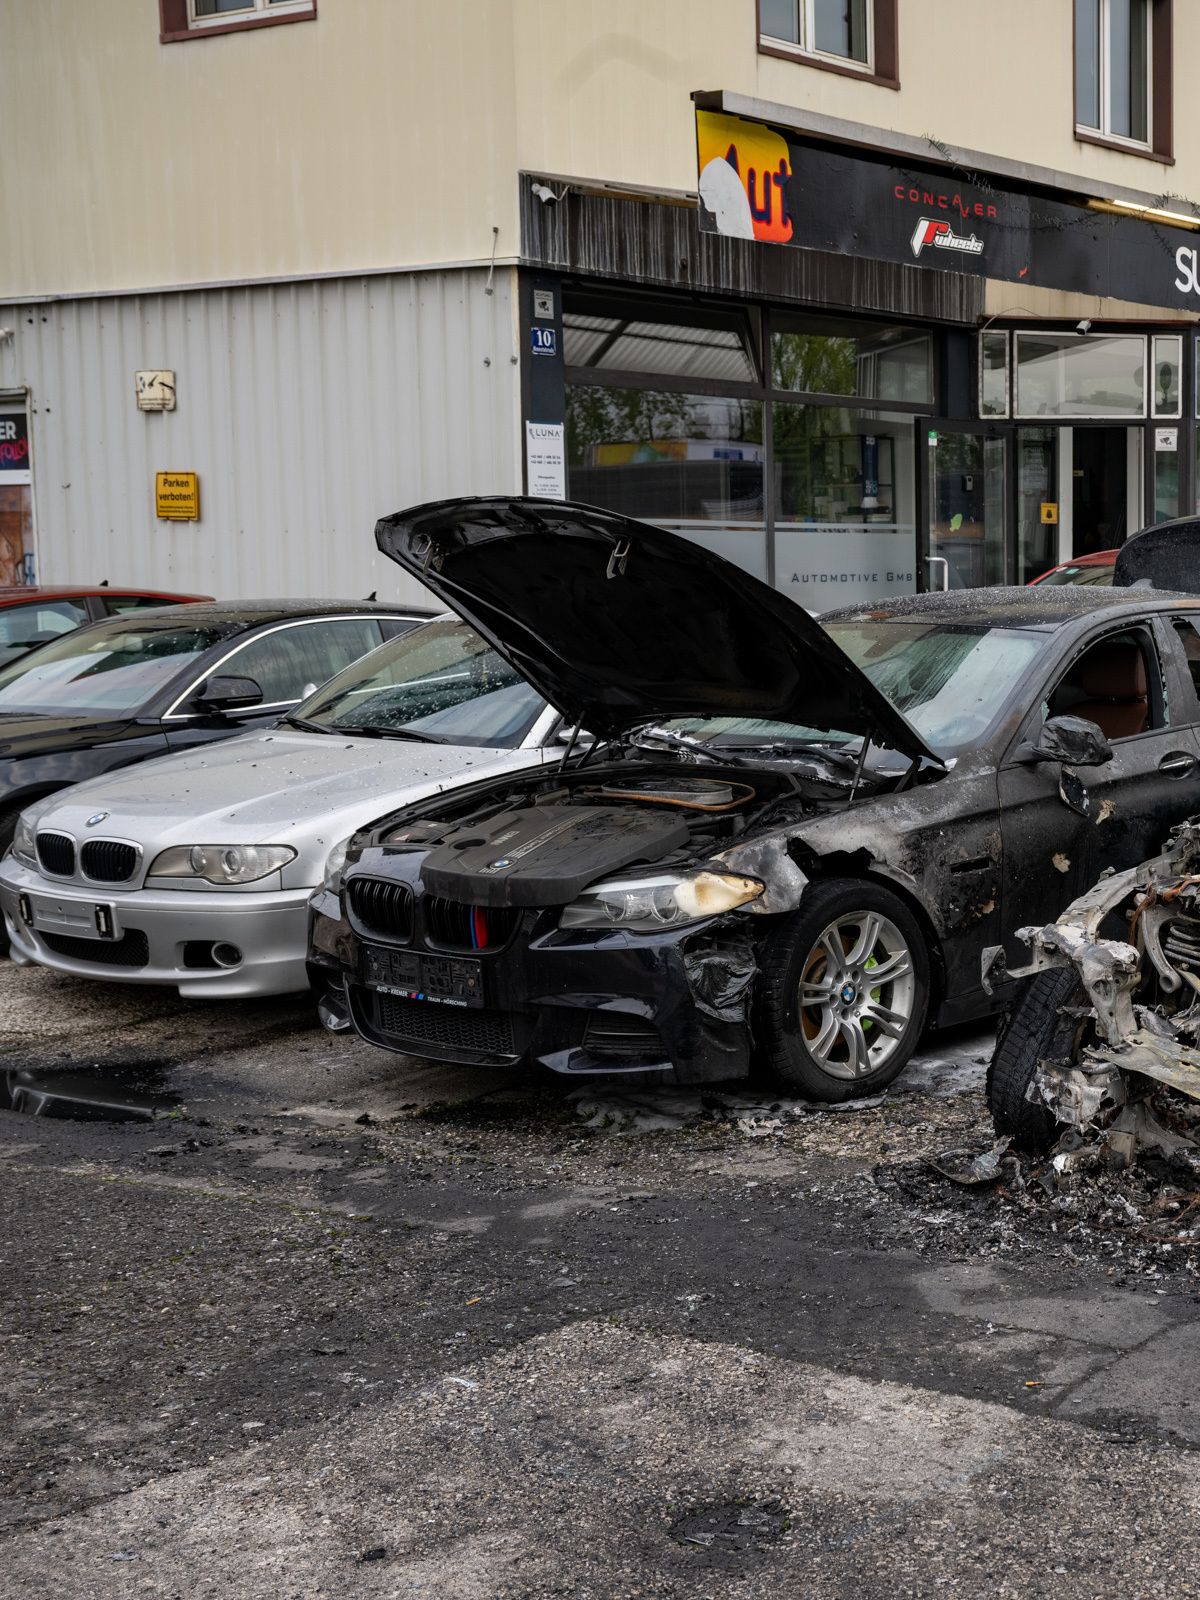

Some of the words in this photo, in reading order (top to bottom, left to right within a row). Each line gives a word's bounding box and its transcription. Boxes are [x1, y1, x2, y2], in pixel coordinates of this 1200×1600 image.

[894, 185, 997, 218] CONCAVER
[536, 330, 552, 347] 10
[535, 428, 561, 438] LUNA
[163, 478, 190, 487] Parken
[158, 492, 194, 501] verboten!
[791, 573, 879, 583] AUTOMOTIVE
[376, 985, 388, 993] AUTO
